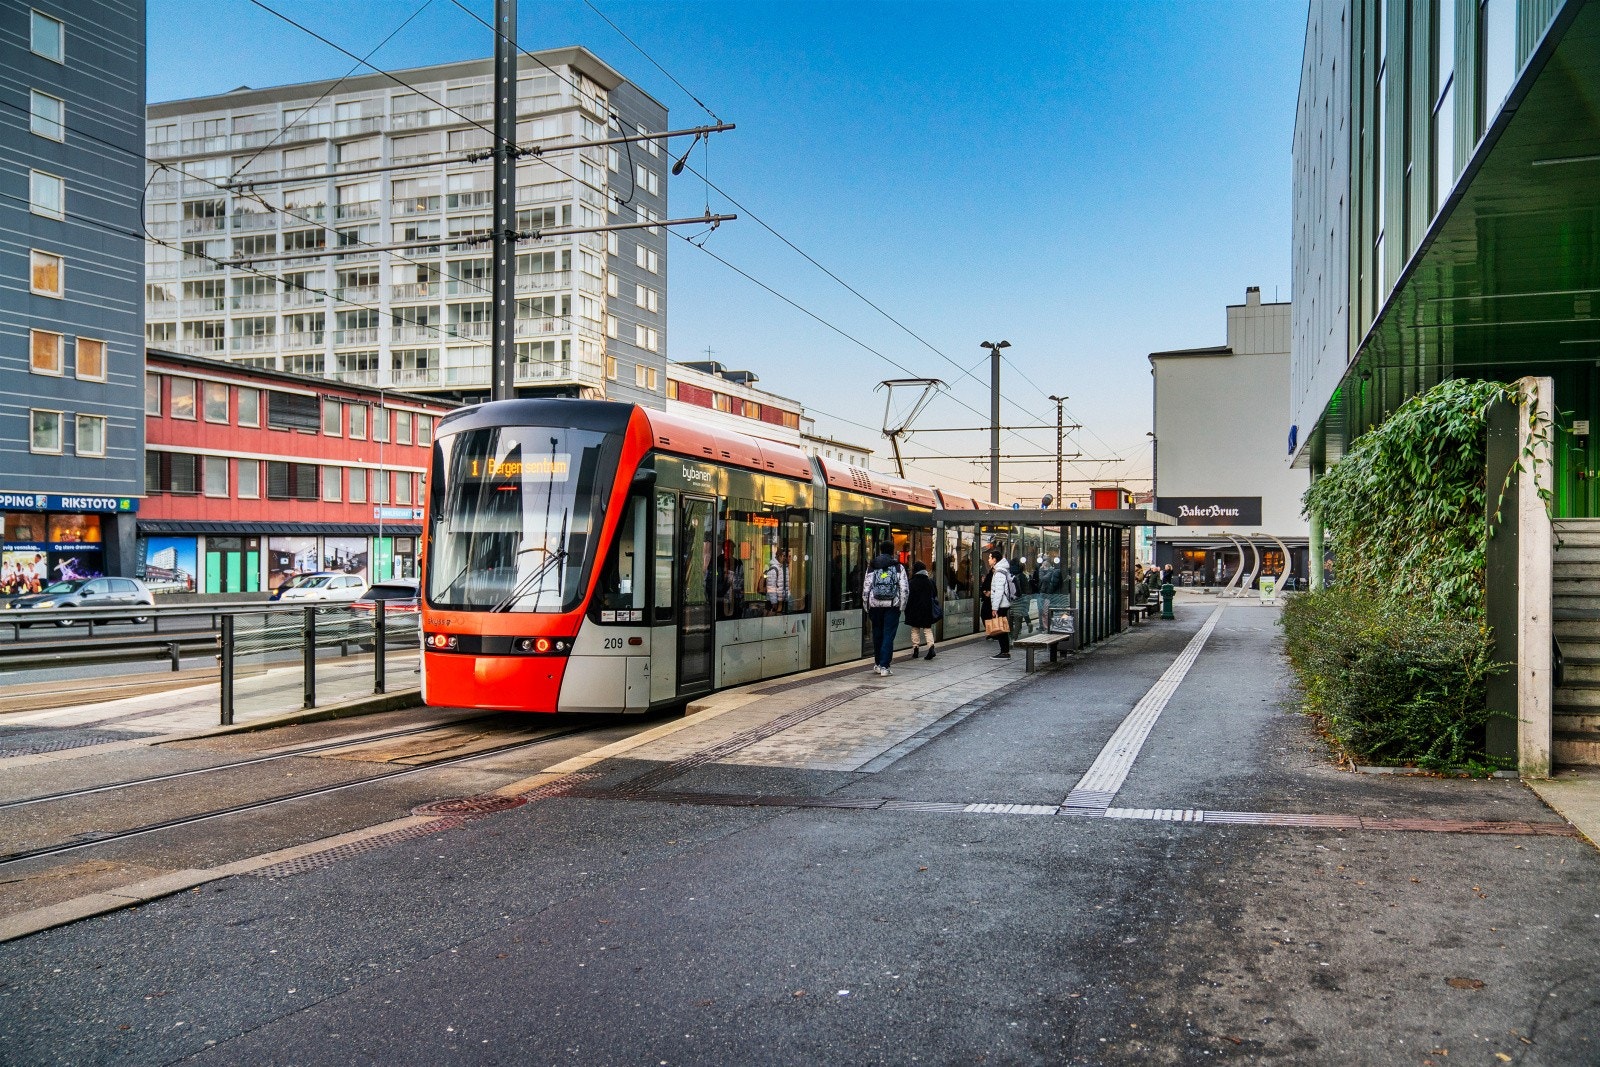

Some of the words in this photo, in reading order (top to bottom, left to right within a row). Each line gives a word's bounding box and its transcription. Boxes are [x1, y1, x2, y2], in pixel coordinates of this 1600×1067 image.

[472, 460, 478, 476] 1
[488, 458, 522, 477] Bergen
[525, 457, 566, 473] sentrum
[682, 464, 711, 481] bybanen
[62, 498, 116, 509] RIKSTOTO
[1178, 505, 1239, 517] BakerBrun
[604, 638, 623, 649] 209
